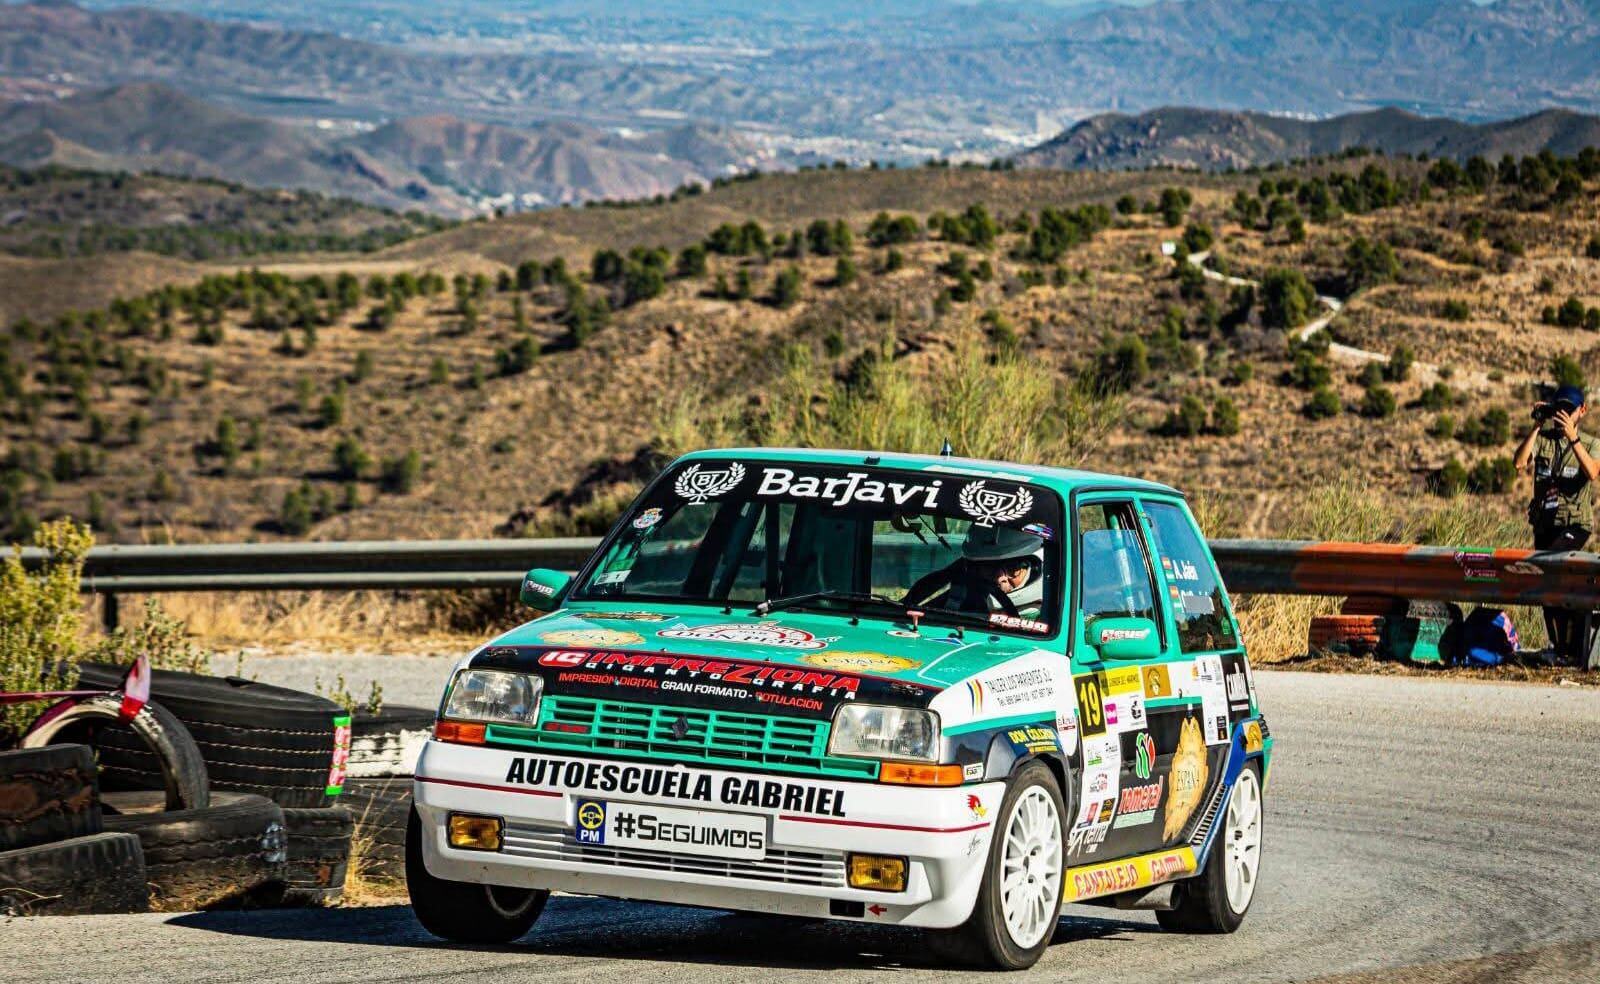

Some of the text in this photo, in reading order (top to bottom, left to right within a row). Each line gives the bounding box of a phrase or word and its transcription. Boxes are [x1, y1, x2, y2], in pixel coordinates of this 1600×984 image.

[697, 474, 720, 489] BJ
[757, 468, 943, 508] BarJavi
[983, 494, 1008, 509] BJ
[544, 651, 587, 664] IG
[590, 652, 861, 692] IMPREZIONA
[558, 672, 616, 685] IMPRESIÓN
[619, 675, 659, 689] DIGITAL
[661, 680, 693, 693] GRAN
[694, 683, 748, 699] FORMATO
[755, 690, 824, 711] ROTULACIÓN
[1079, 681, 1102, 727] 19
[506, 757, 846, 818] AUTOESCUELA GABRIEL
[580, 829, 601, 843] PM
[1074, 864, 1139, 898] CANTALEJO
